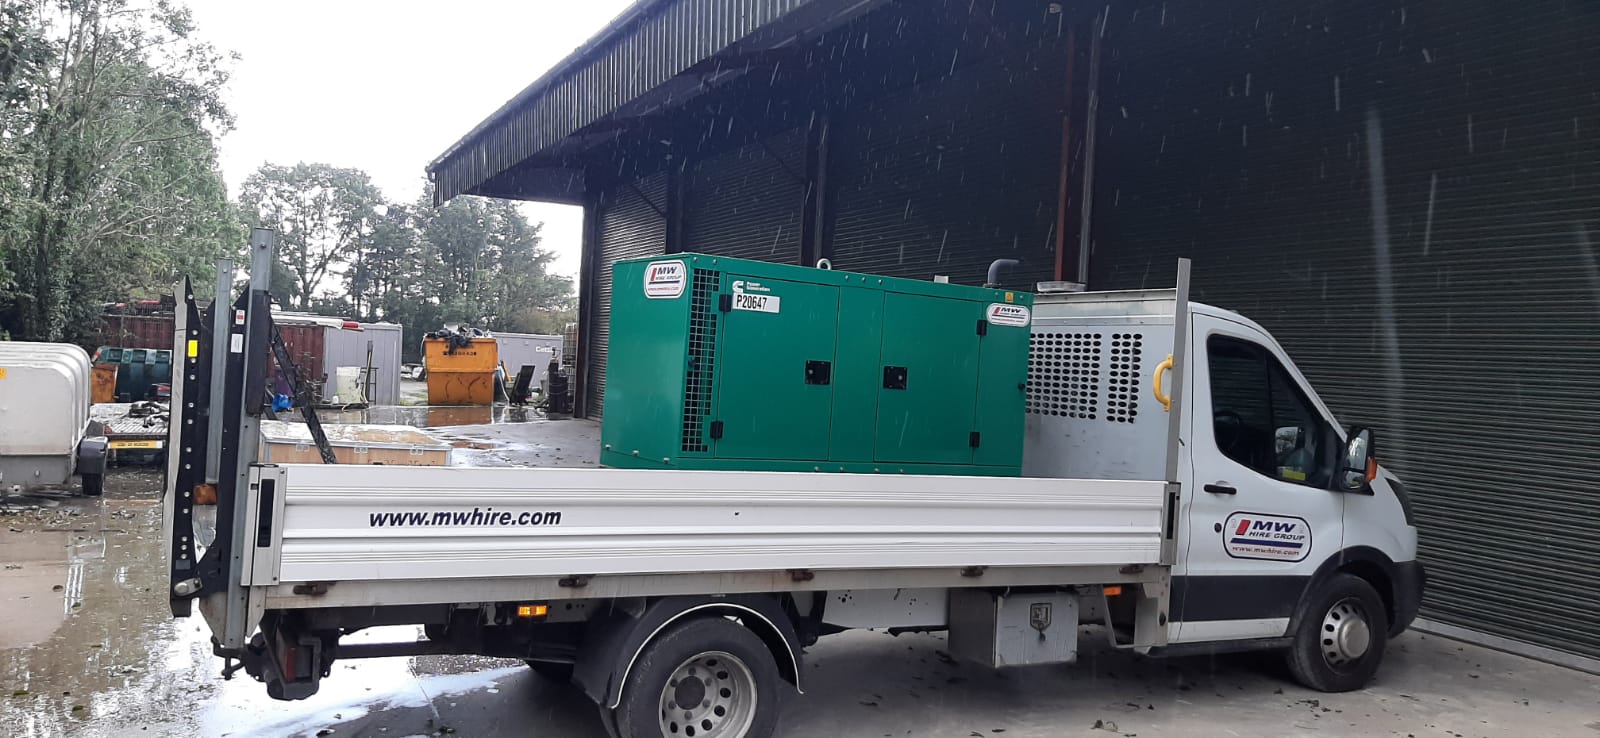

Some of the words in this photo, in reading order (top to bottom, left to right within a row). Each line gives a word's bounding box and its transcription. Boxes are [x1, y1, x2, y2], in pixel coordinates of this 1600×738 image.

[657, 266, 677, 275] MW
[736, 294, 767, 310] P20647
[369, 507, 562, 527] www.mwhire.com
[1252, 520, 1296, 533] MW
[1273, 533, 1305, 541] GROUP
